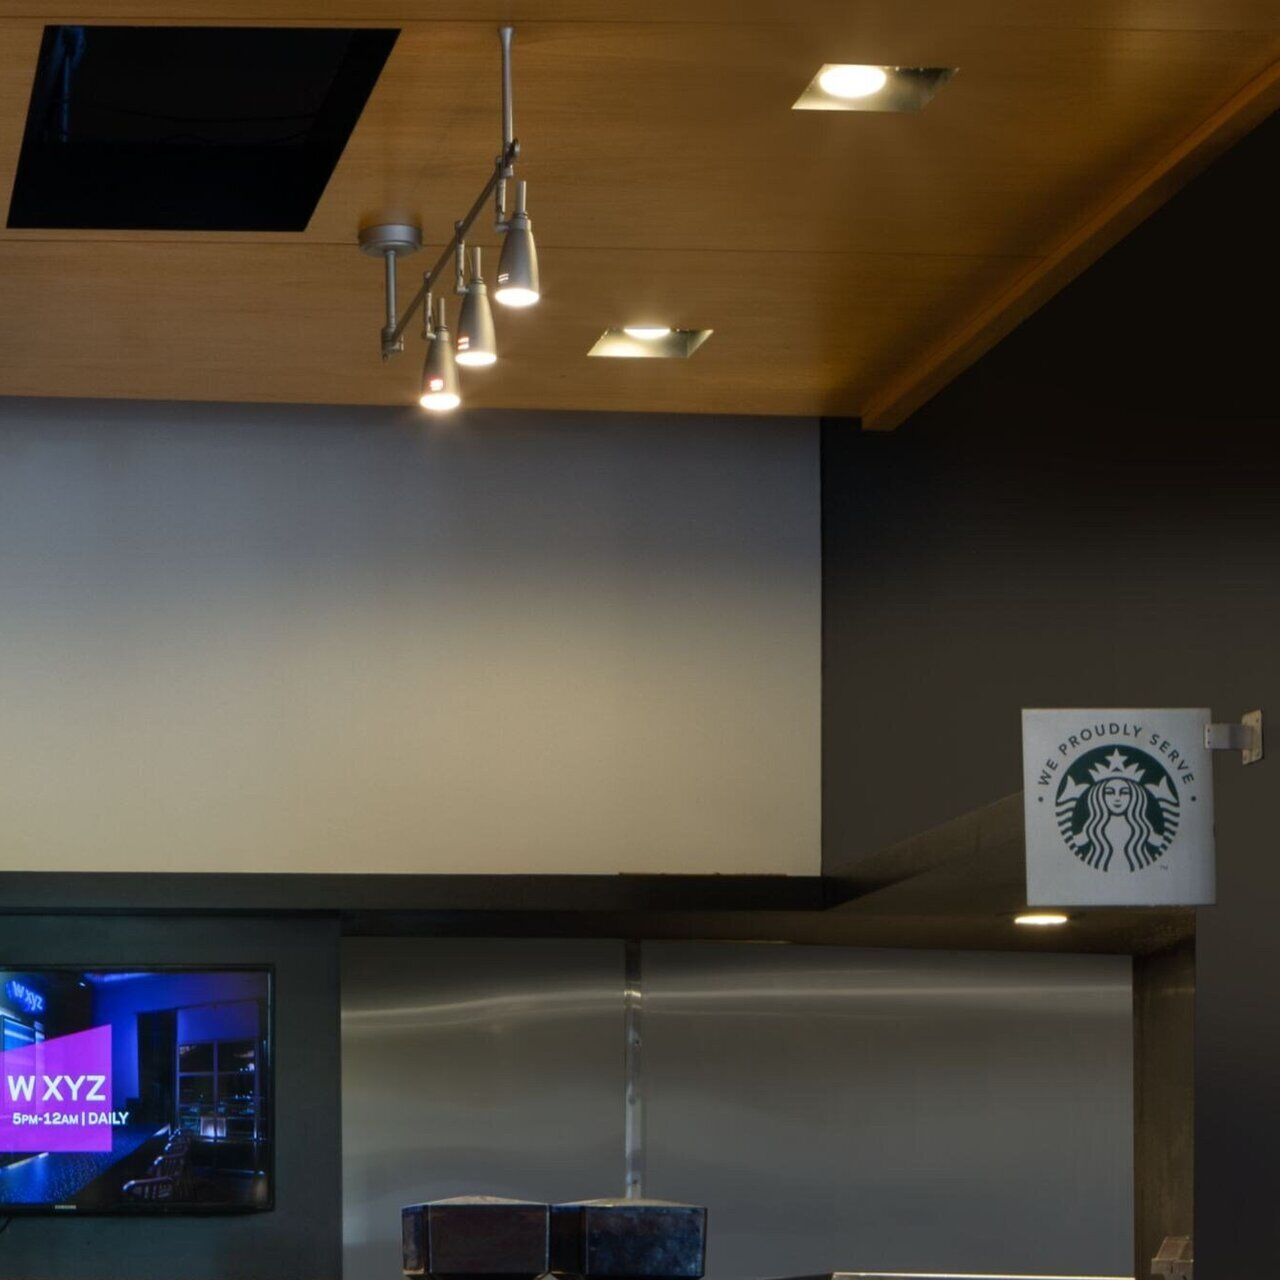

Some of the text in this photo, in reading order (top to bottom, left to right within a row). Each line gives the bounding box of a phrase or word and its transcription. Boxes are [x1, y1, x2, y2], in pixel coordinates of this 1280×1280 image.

[1038, 722, 1194, 786] WE PROUDLY SERVE
[12, 1112, 129, 1126] 5PM-12AM DAILY
